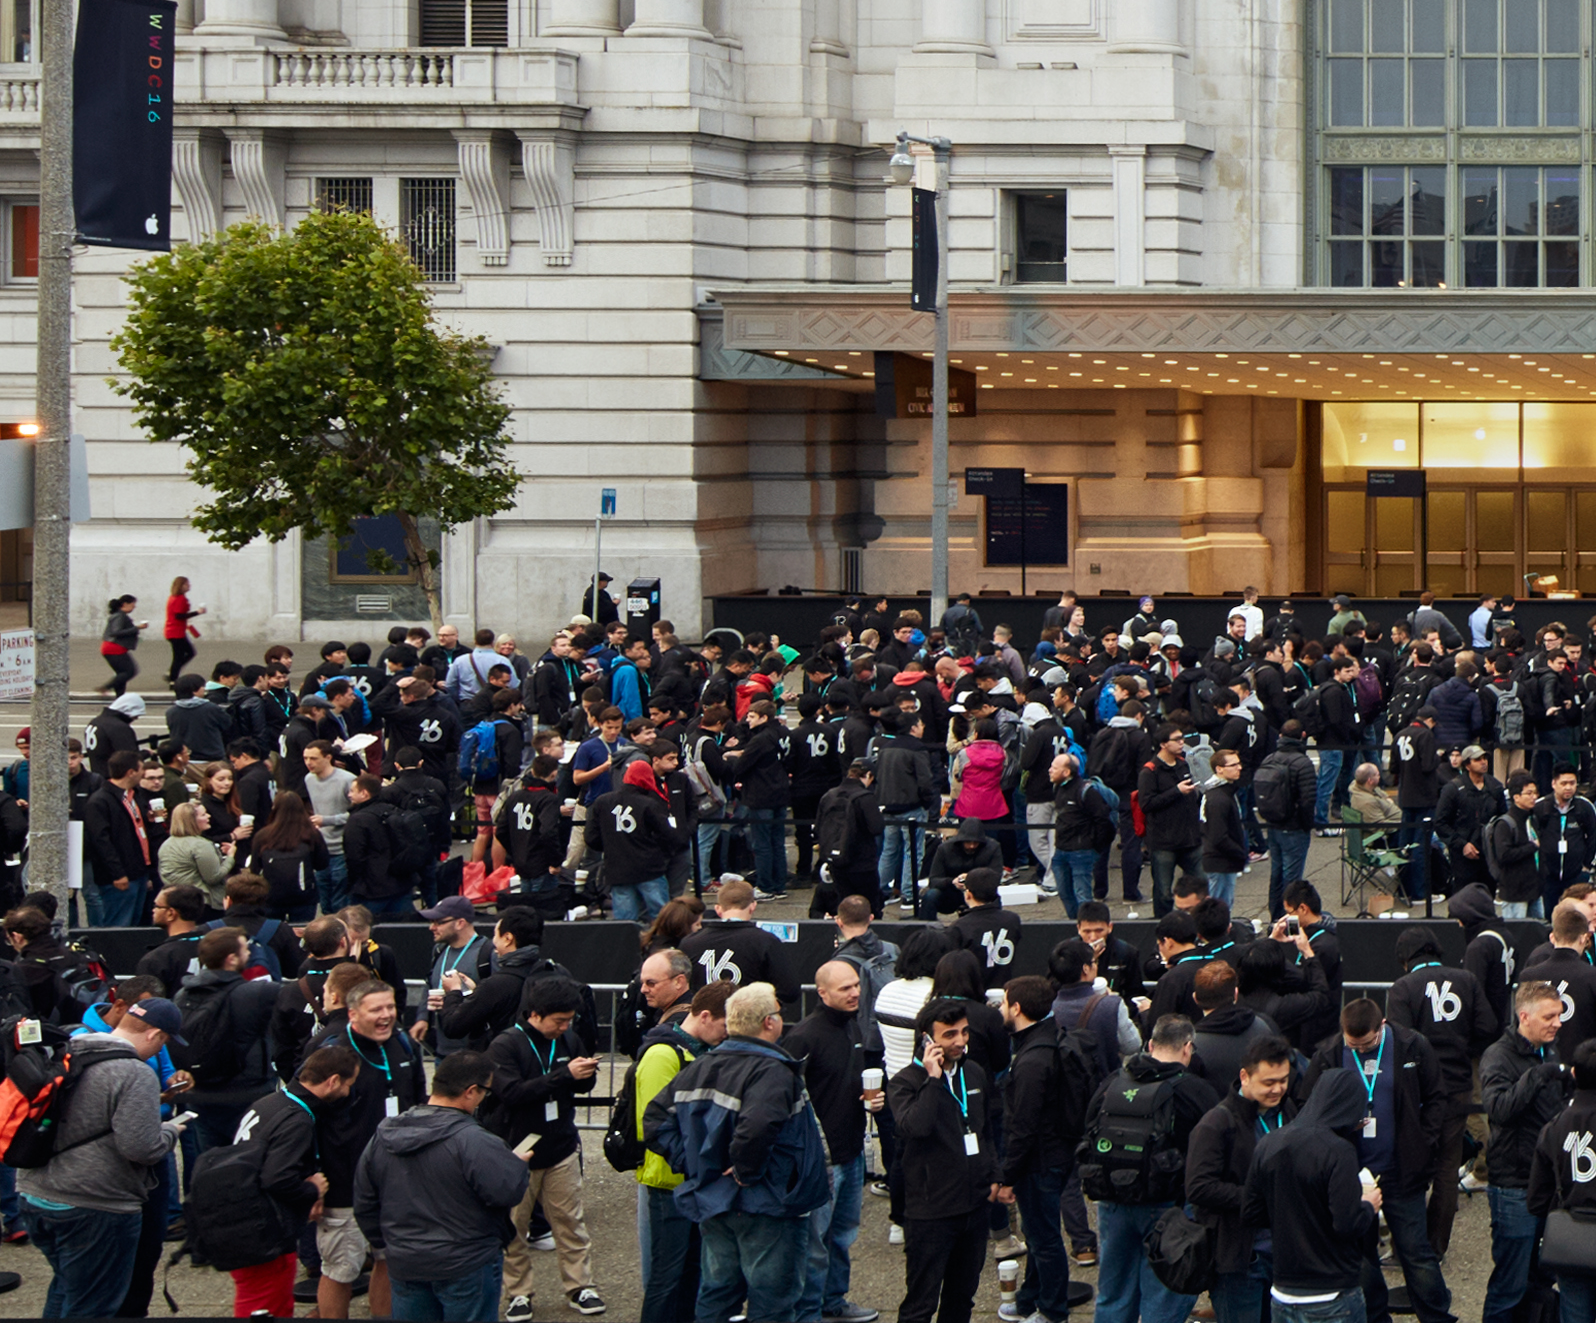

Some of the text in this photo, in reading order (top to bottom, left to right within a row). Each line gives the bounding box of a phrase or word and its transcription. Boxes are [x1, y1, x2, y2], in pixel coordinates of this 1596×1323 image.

[147, 14, 164, 124] WWDC16
[2, 634, 34, 651] PARKING
[15, 654, 22, 667] 6
[806, 733, 828, 757] 16
[1397, 736, 1414, 761] 16
[512, 802, 533, 830] 16
[612, 804, 637, 833] 16
[981, 928, 1014, 968] 16
[699, 949, 742, 985] 16
[1425, 981, 1462, 1022] 16
[1545, 980, 1575, 1022] 6
